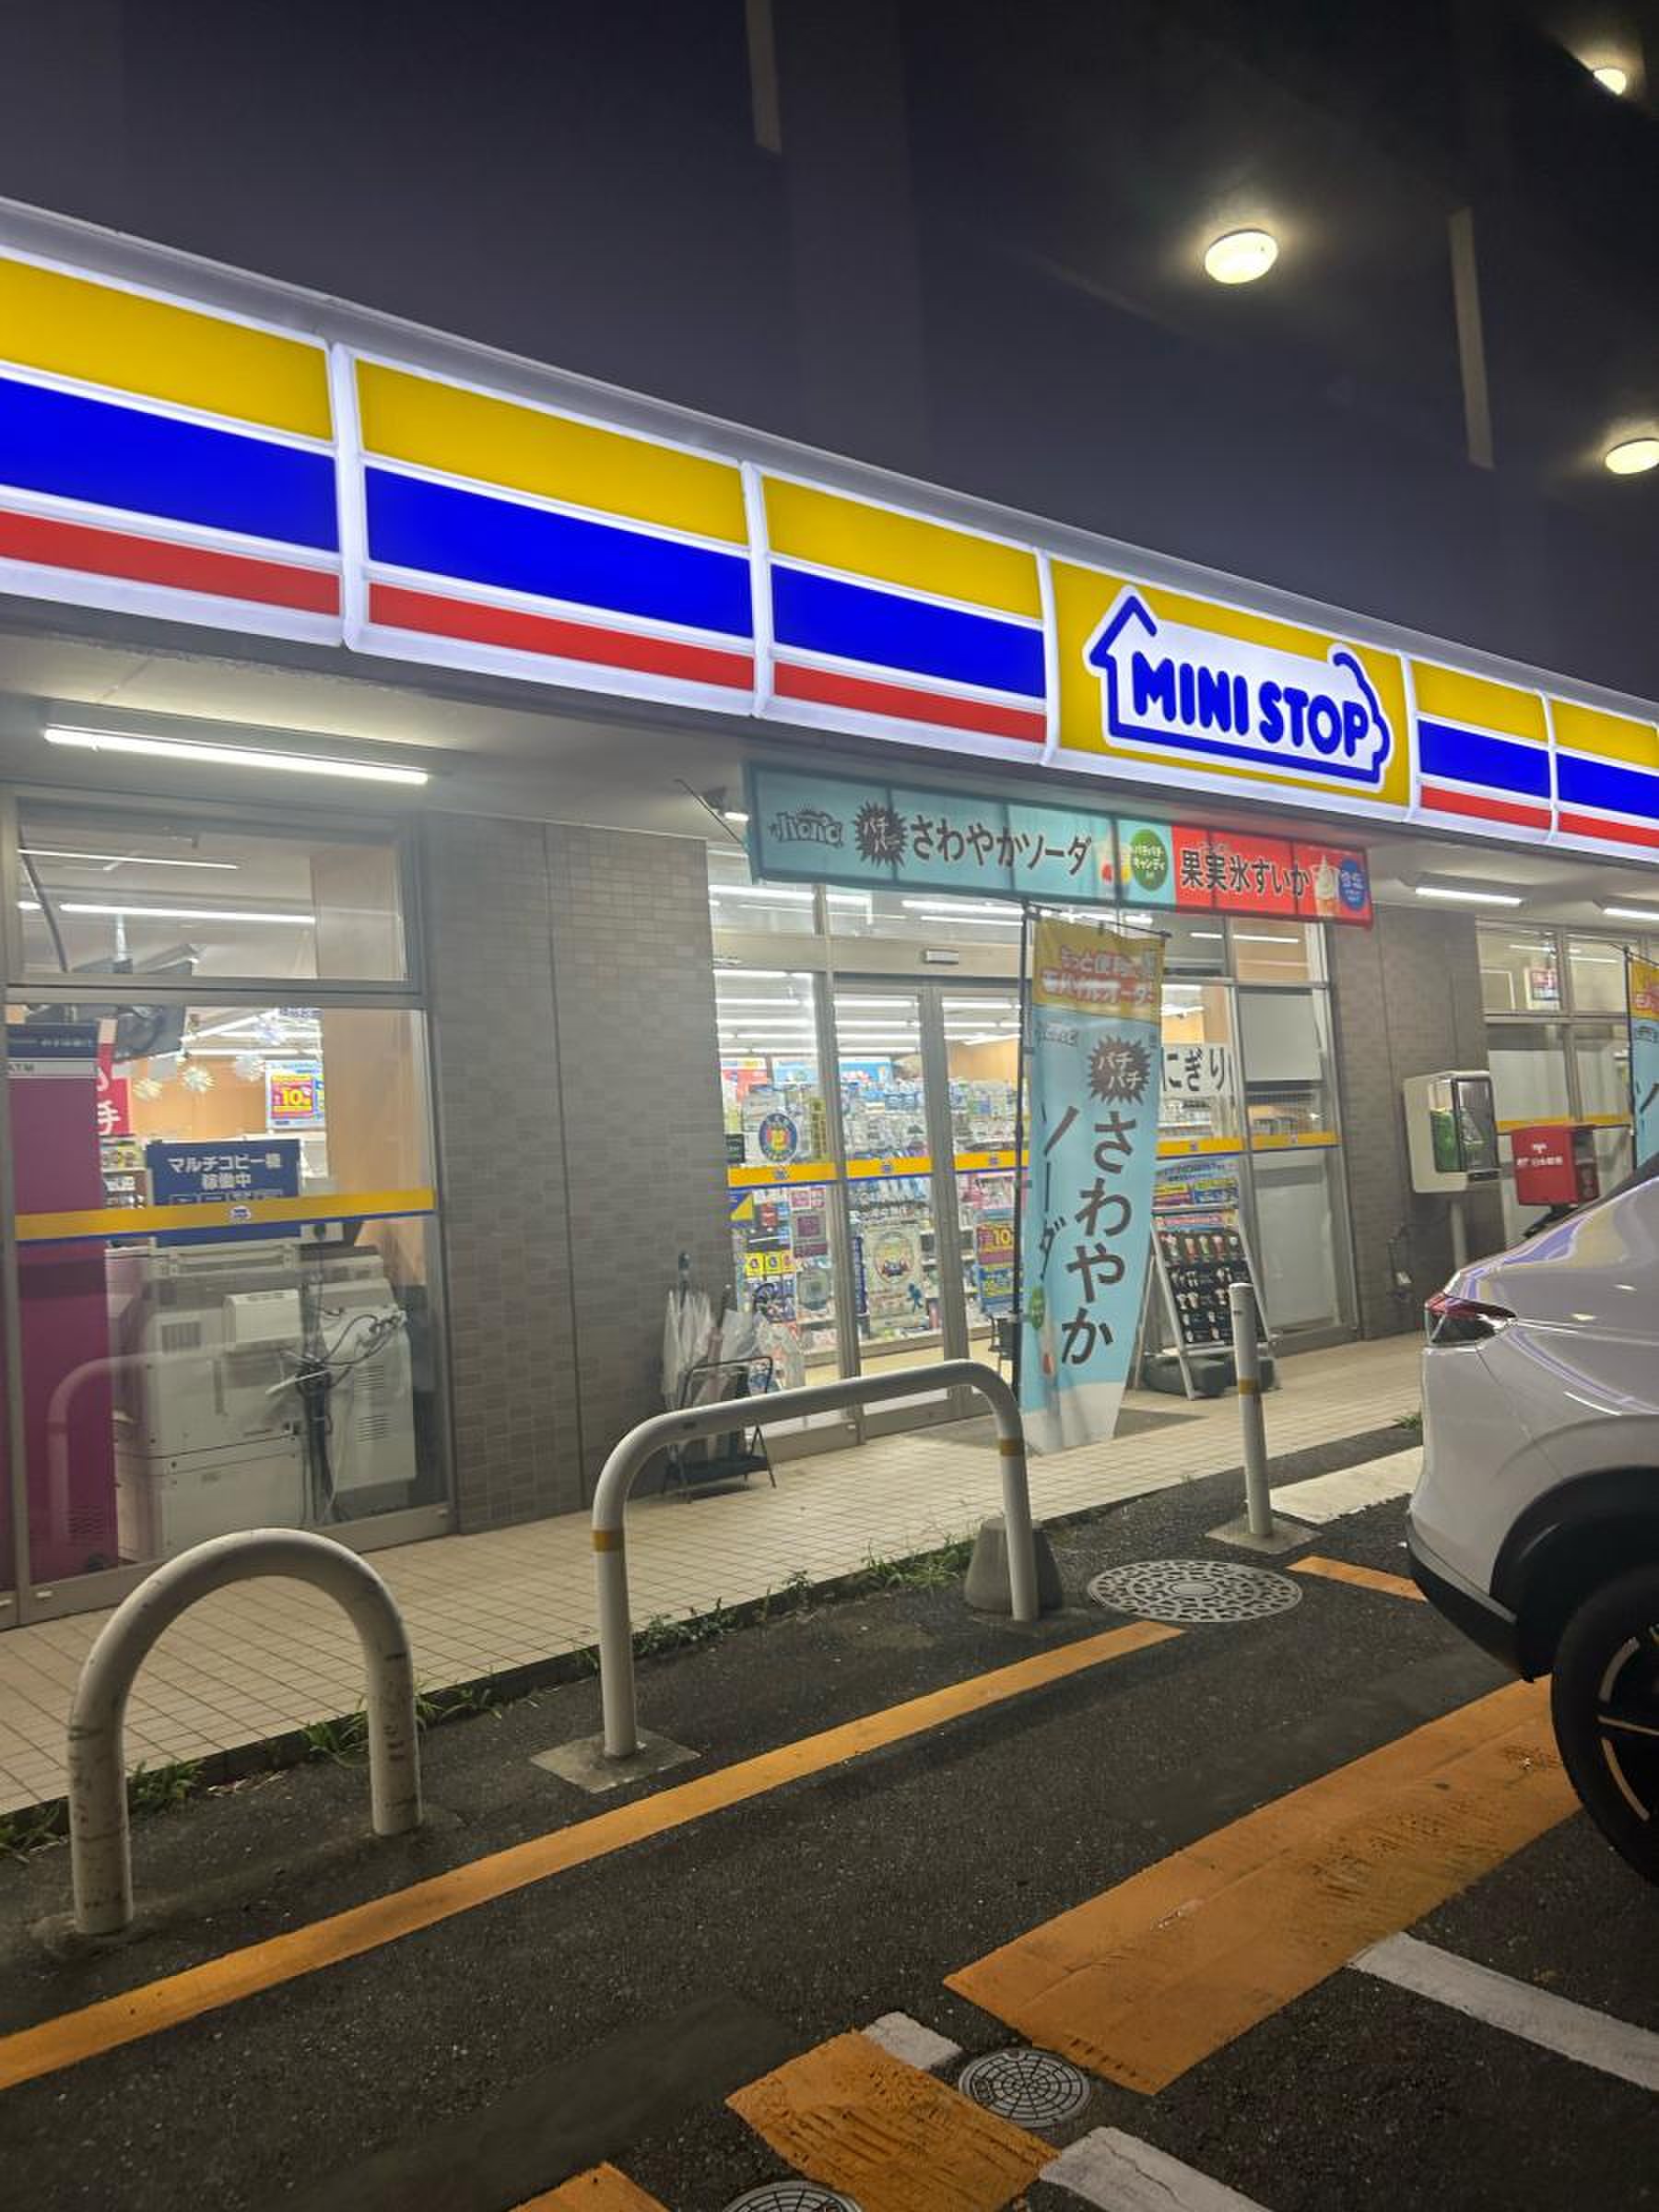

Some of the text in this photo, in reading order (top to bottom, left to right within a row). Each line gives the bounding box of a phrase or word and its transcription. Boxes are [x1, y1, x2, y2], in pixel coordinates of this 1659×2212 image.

[1132, 651, 1369, 758] MINI STOP
[911, 814, 1092, 875] さわやかソーダ
[1181, 849, 1310, 897] 果実氷すいか
[1098, 1051, 1135, 1071] パチ
[1109, 1068, 1142, 1090] パチ
[1061, 1110, 1137, 1366] さわやか
